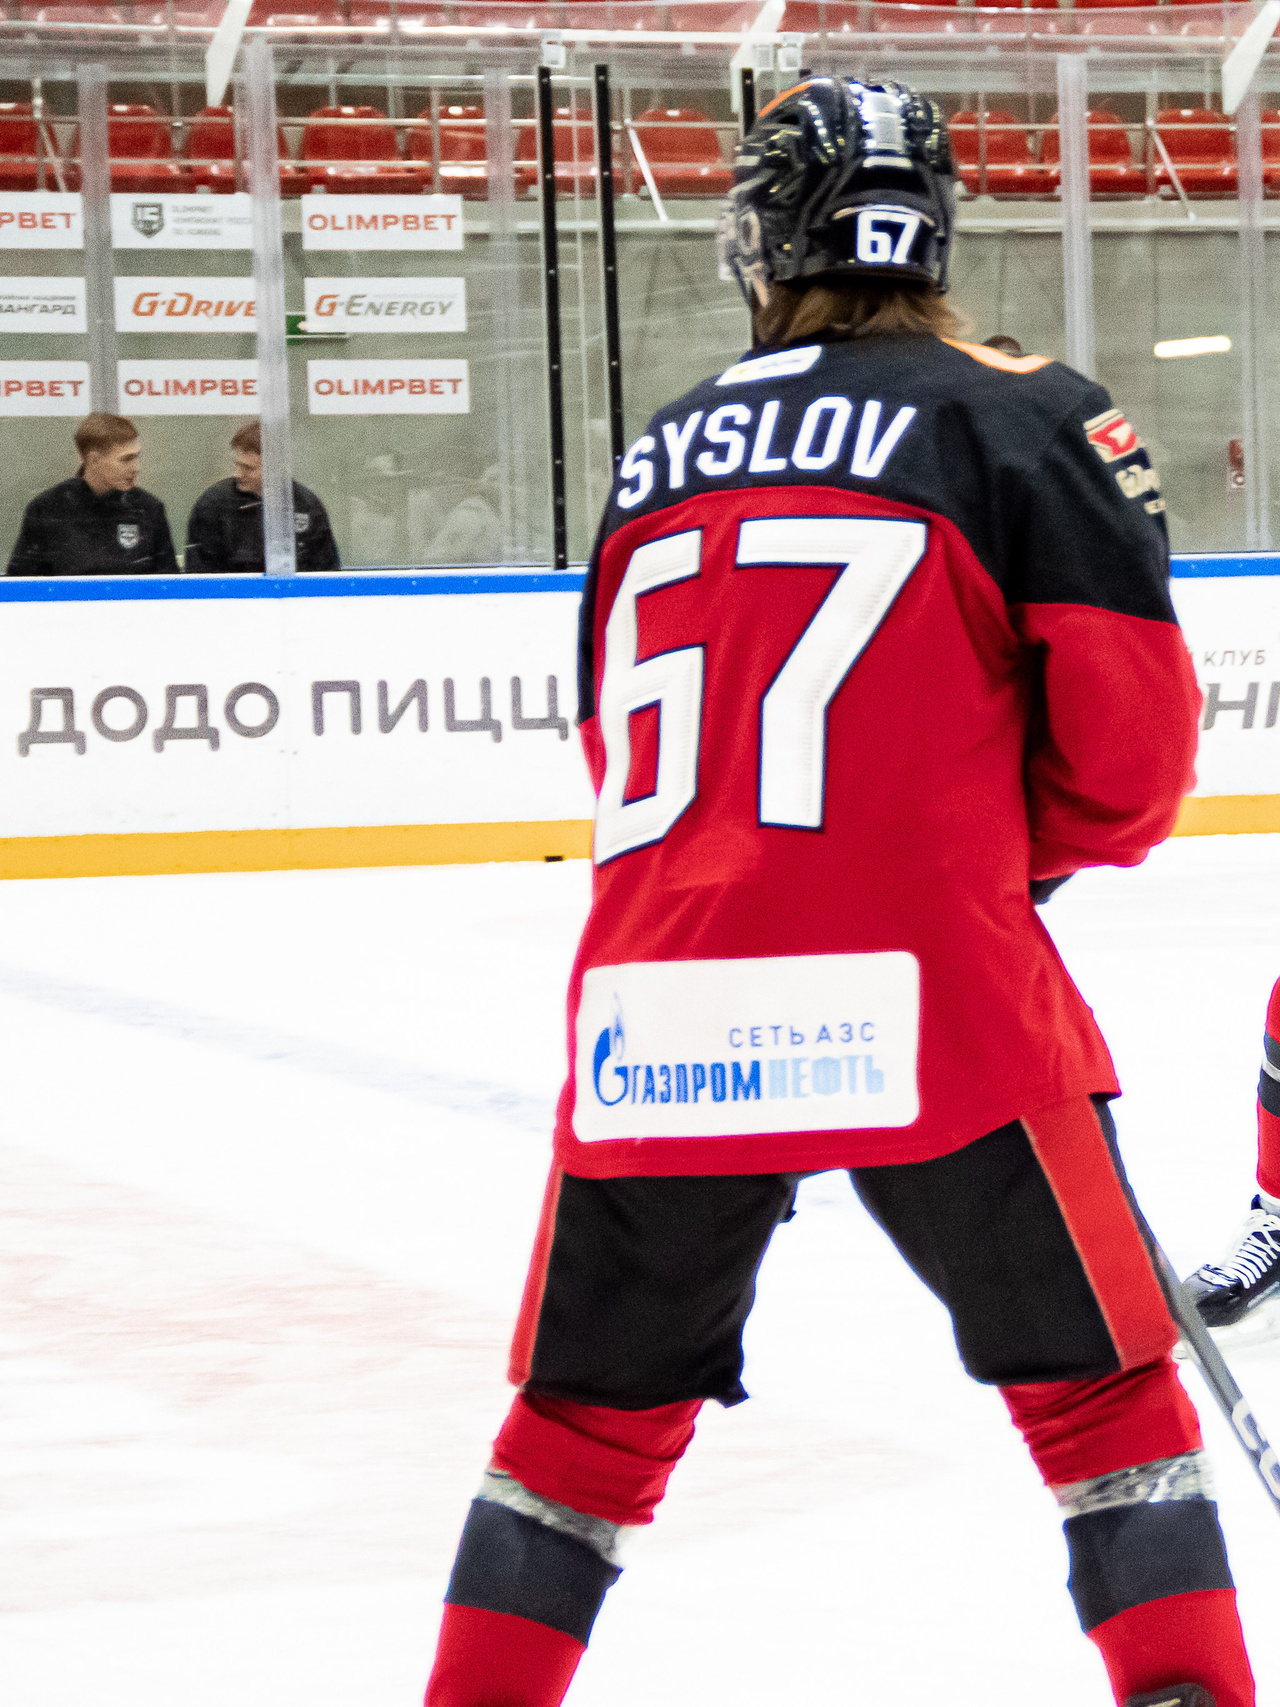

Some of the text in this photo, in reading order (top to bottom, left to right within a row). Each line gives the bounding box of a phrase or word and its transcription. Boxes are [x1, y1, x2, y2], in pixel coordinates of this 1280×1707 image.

[308, 214, 458, 231] OLIMPBET
[855, 209, 921, 265] 67
[0, 304, 77, 315] АНГАРД
[0, 380, 84, 397] PBET
[124, 379, 257, 396] OLIMPBE
[314, 378, 463, 396] OLIMPBET
[616, 395, 917, 509] SYSLOV
[1203, 650, 1266, 667] КЛУБ
[592, 515, 929, 869] 67
[17, 674, 569, 757] ДОДО ПИЦЦ
[729, 1022, 876, 1048] СЕТЬ АЗС
